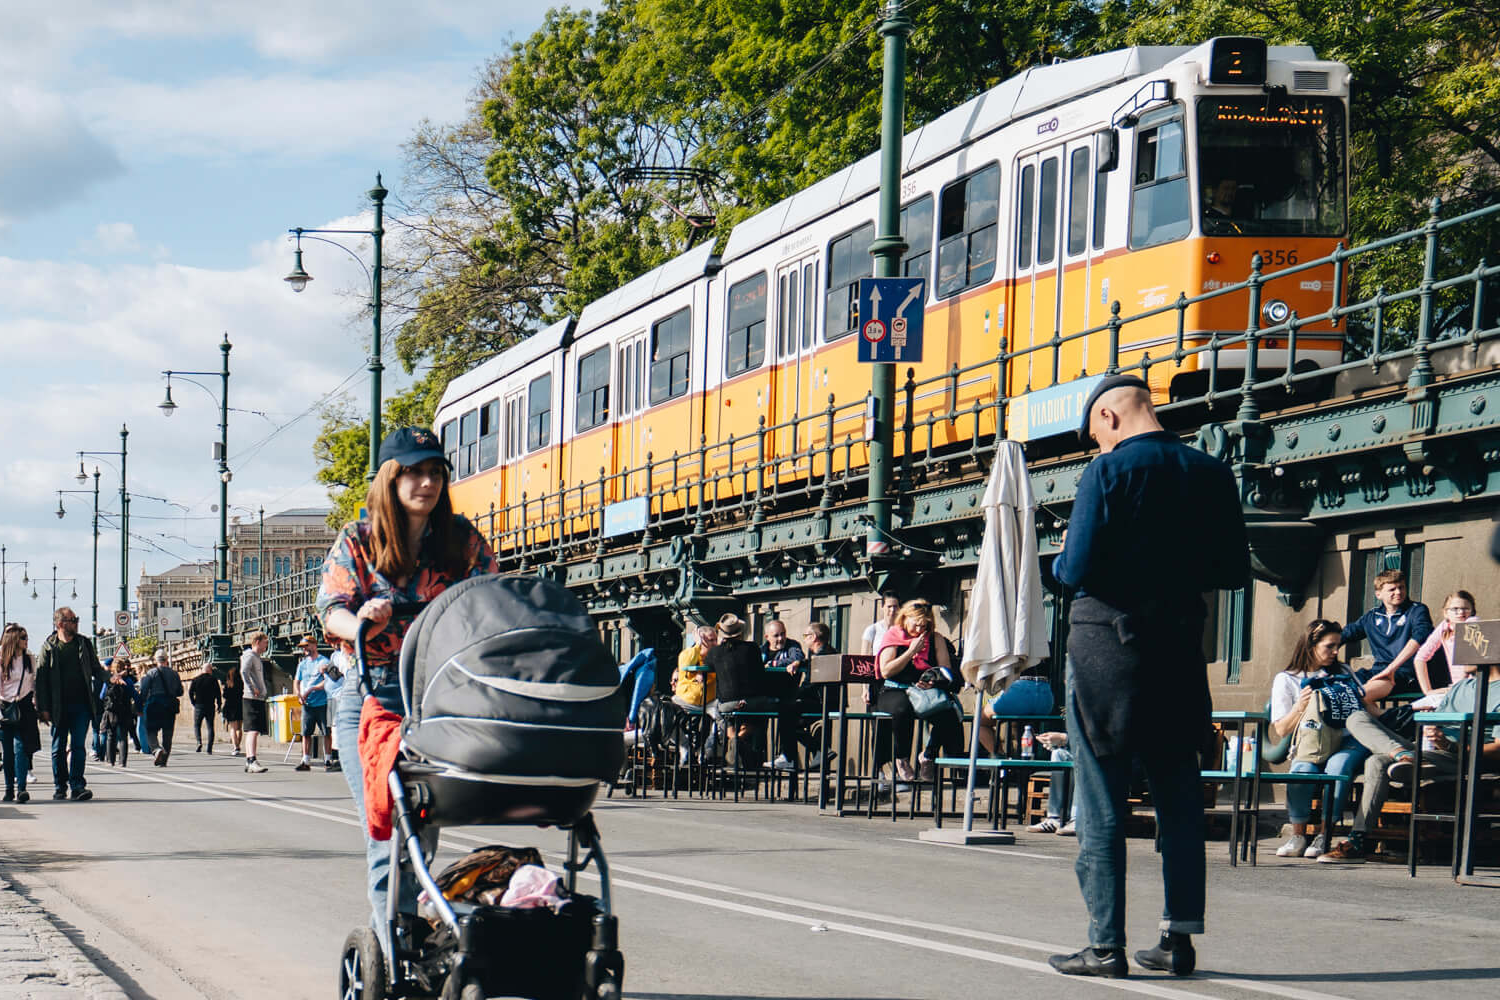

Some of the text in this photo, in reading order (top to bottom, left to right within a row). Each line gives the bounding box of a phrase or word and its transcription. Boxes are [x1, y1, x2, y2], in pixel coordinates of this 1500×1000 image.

[902, 180, 917, 199] 356
[1252, 249, 1299, 265] 356
[1030, 394, 1073, 427] VIADUKT
